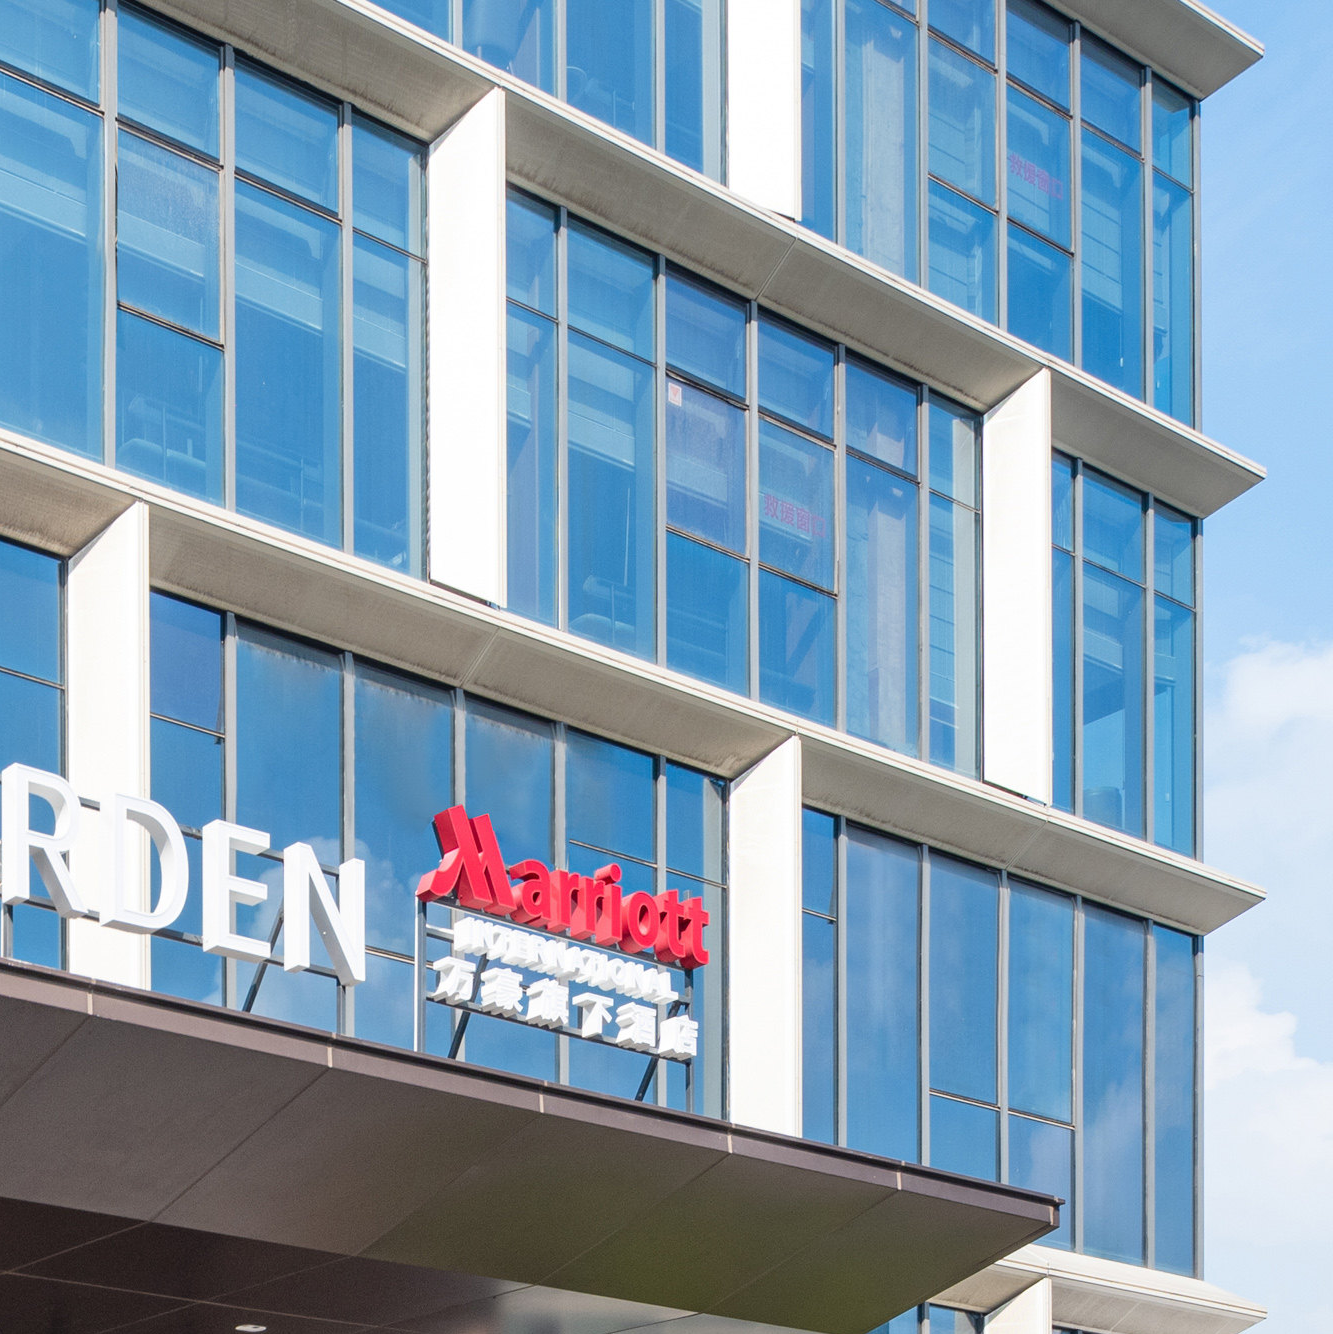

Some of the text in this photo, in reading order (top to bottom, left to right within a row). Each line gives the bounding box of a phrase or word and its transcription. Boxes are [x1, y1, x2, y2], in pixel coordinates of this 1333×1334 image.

[1010, 152, 1063, 200] 救援窗口
[764, 493, 826, 538] 救援窗口
[416, 804, 709, 970] Marriott
[453, 916, 679, 1004] INTERNATIONAL
[431, 956, 699, 1060] 万豪旗下酒店
